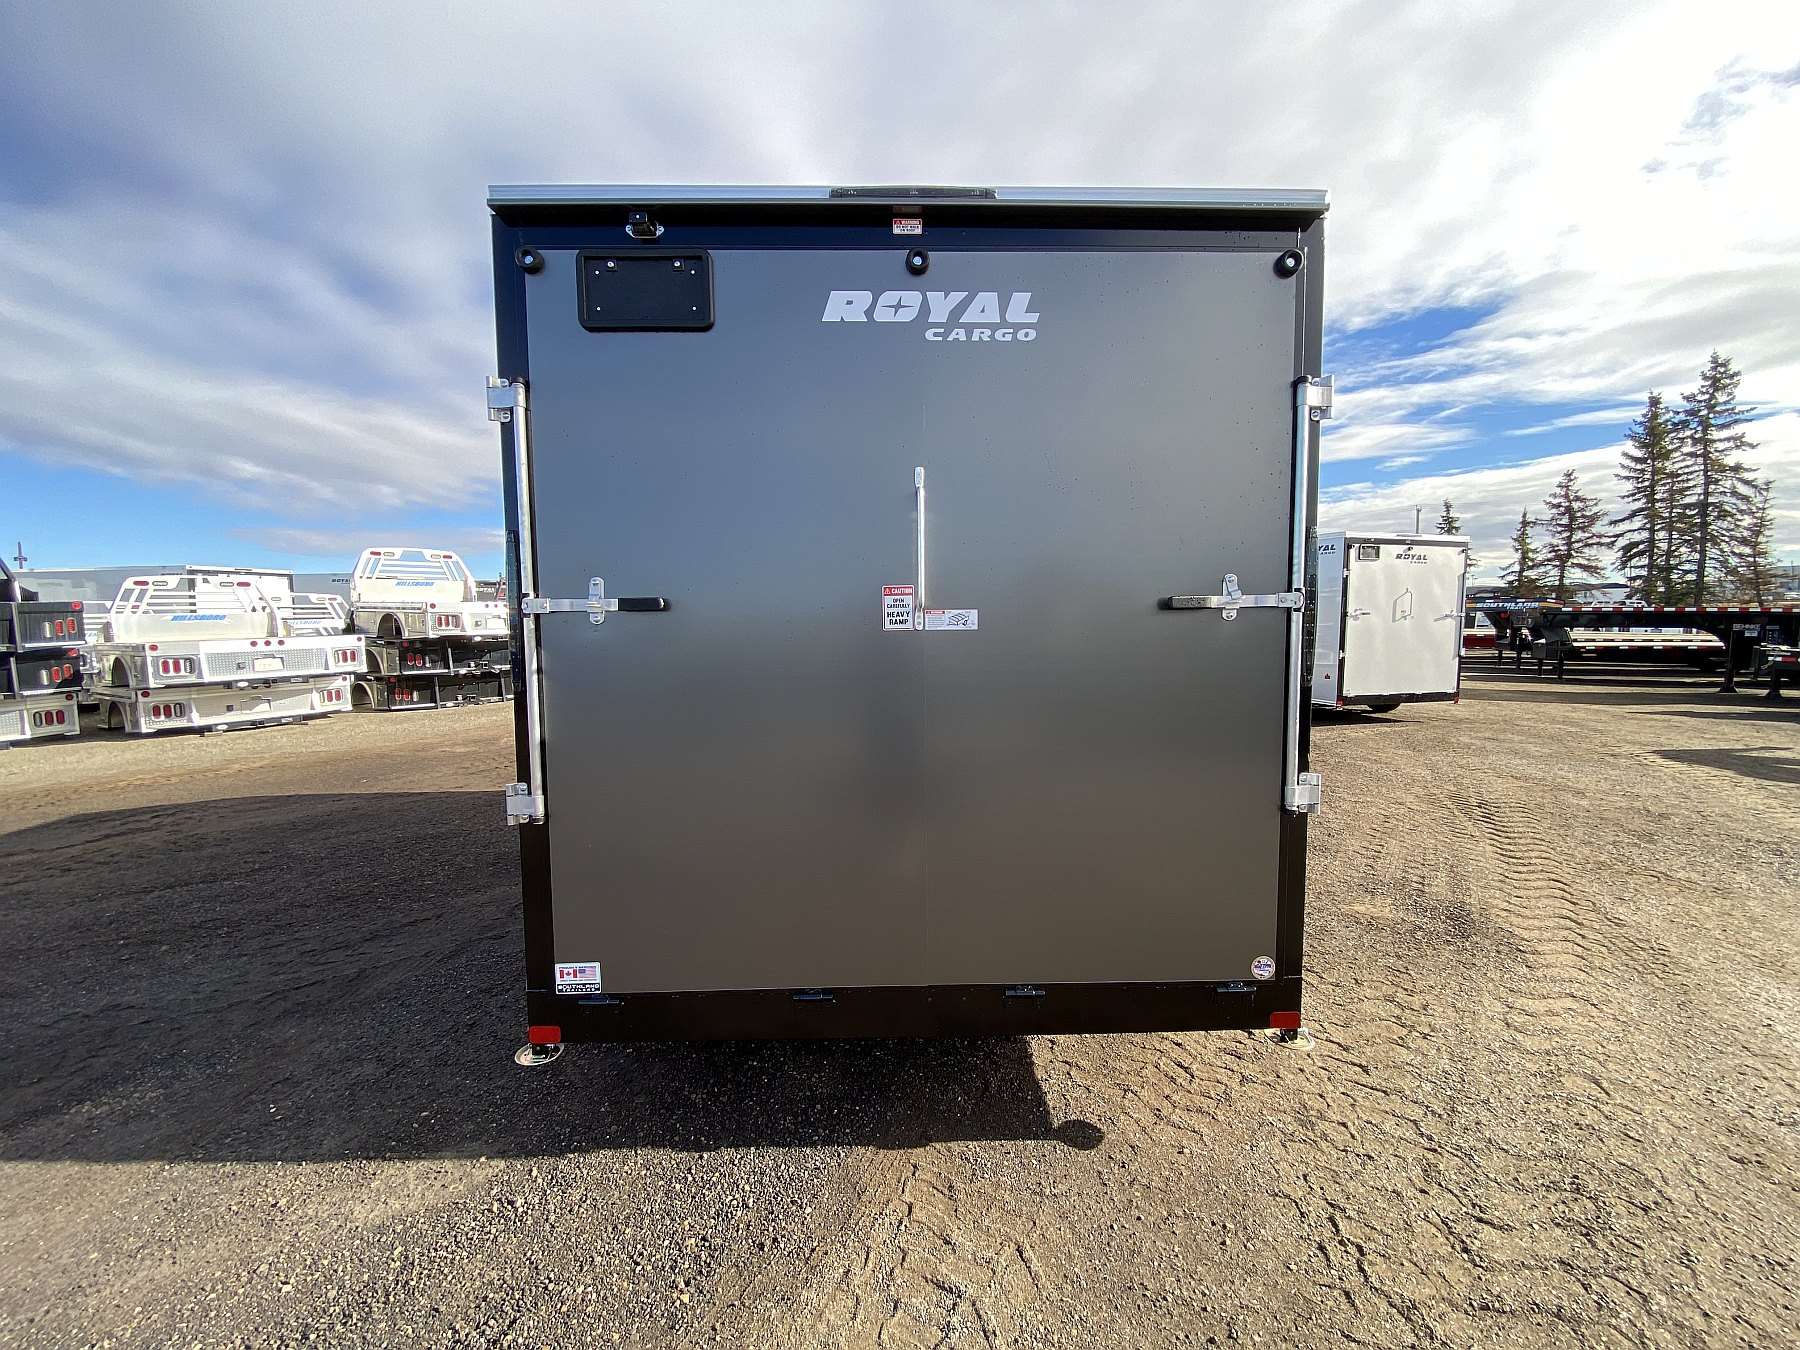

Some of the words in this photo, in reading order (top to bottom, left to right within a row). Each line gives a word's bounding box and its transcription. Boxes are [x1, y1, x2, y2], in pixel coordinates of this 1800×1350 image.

[821, 289, 1041, 324] ROYAL
[924, 328, 1037, 342] CARGO
[1318, 544, 1336, 552] YAL
[1395, 553, 1428, 561] ROYAL
[889, 618, 909, 626] RAMP
